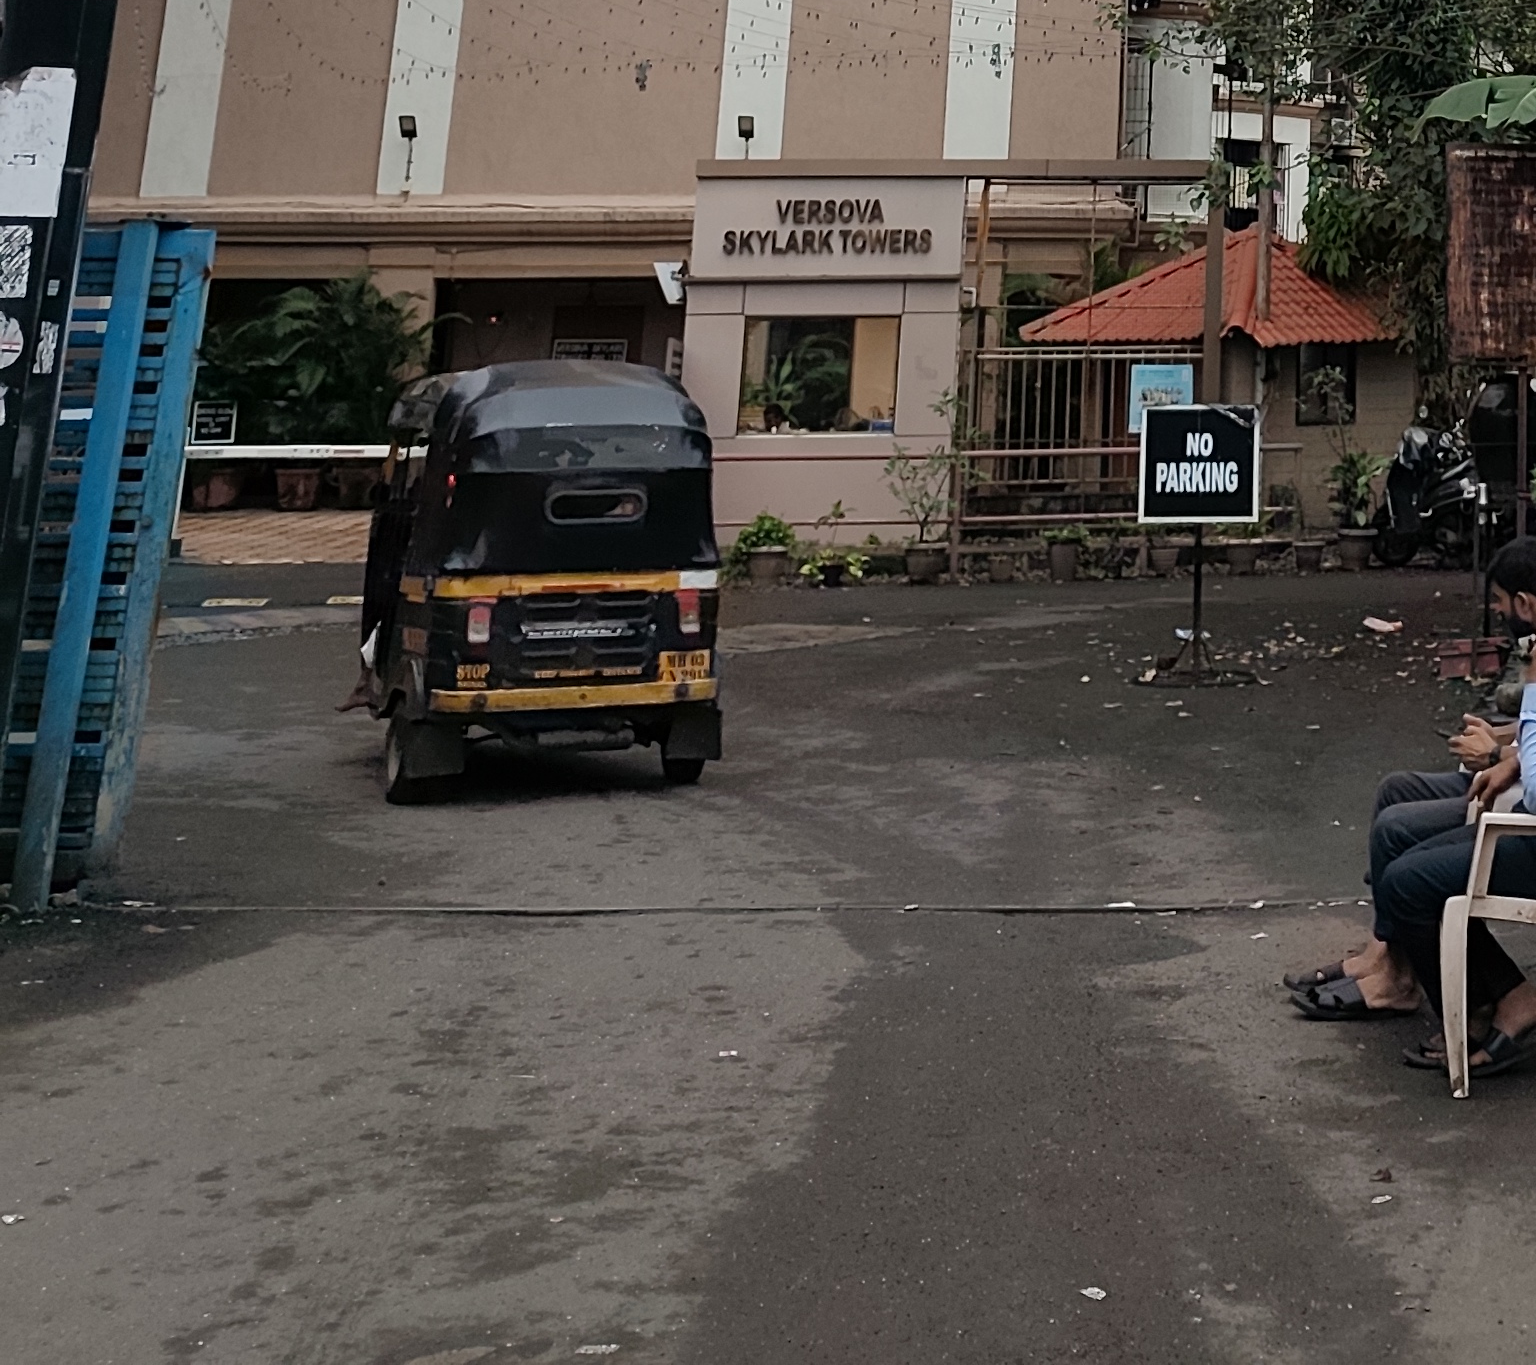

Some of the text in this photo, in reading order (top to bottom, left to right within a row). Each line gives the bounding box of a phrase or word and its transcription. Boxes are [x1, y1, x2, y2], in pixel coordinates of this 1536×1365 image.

[776, 199, 884, 225] VERSOVA
[722, 229, 932, 256] SKYLARK TOWERS
[1185, 432, 1214, 457] NO
[1155, 461, 1239, 494] PARKING
[456, 663, 490, 680] STOP
